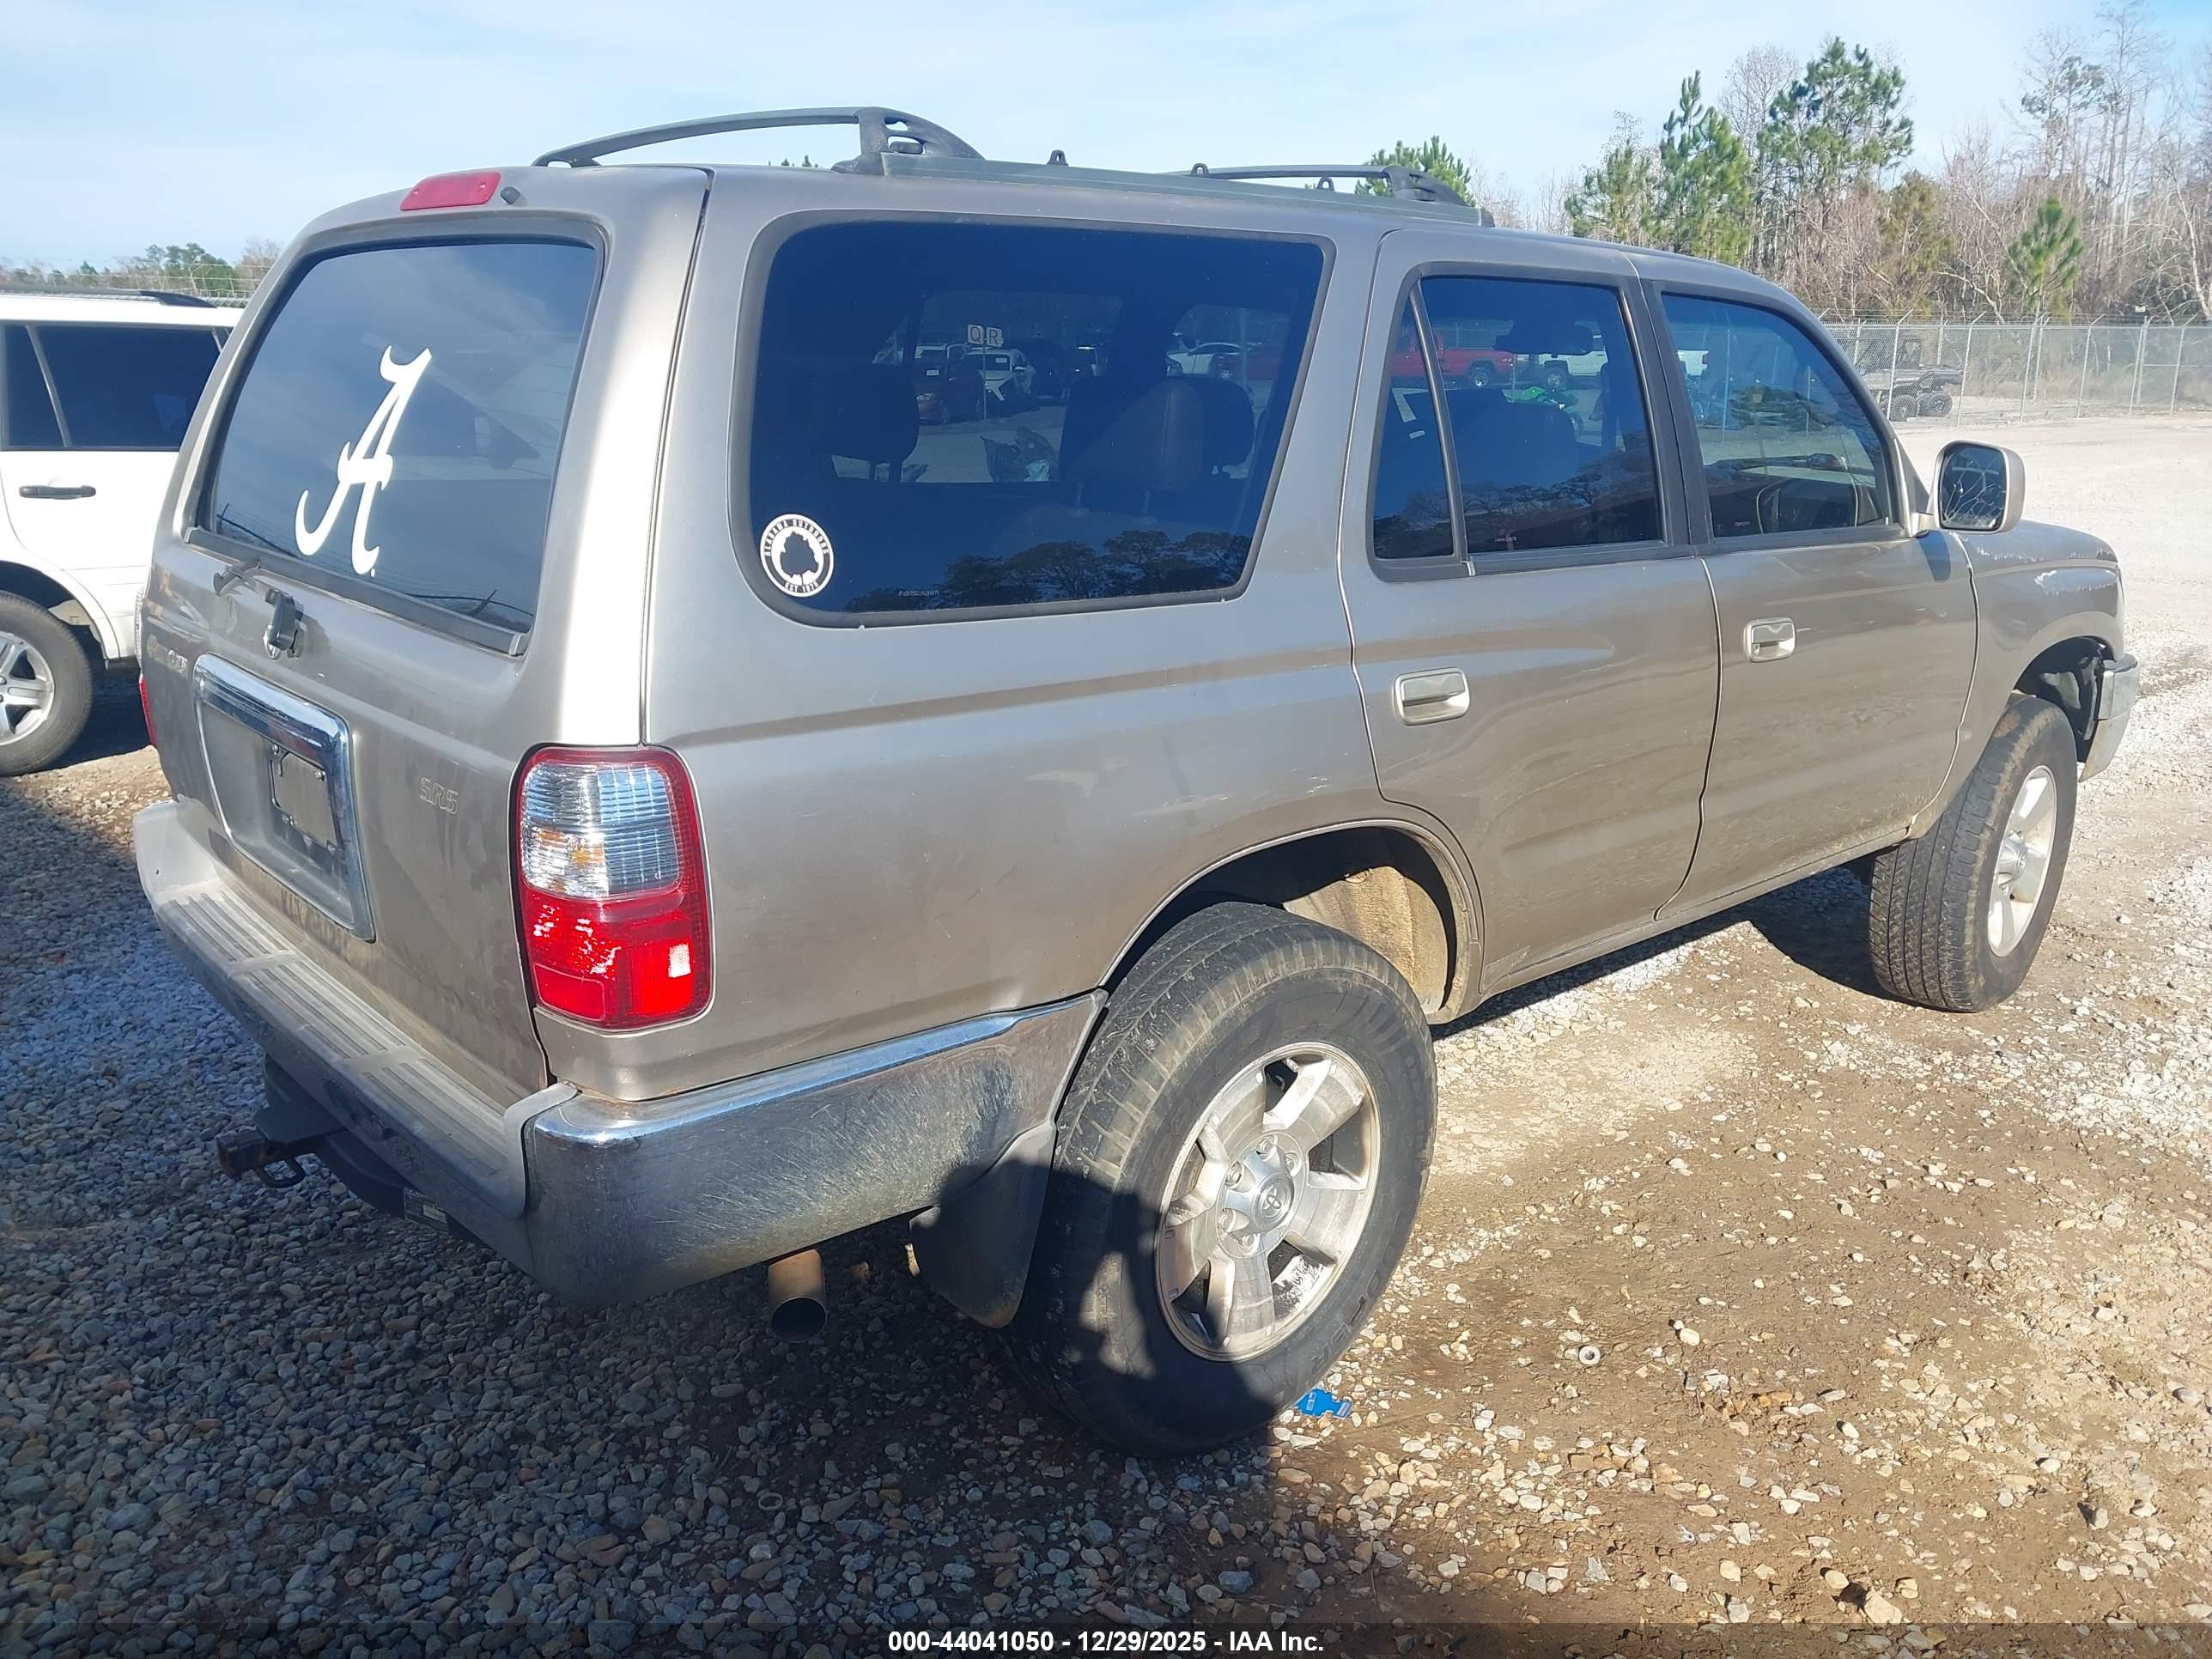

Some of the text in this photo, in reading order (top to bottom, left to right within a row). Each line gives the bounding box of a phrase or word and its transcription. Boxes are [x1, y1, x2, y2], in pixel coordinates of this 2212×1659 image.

[970, 326, 981, 343] Q
[989, 328, 998, 344] R
[295, 345, 432, 574] A
[764, 519, 830, 556] ALABAMA OUTDOORS
[784, 582, 799, 592] EST
[420, 776, 459, 815] SR5
